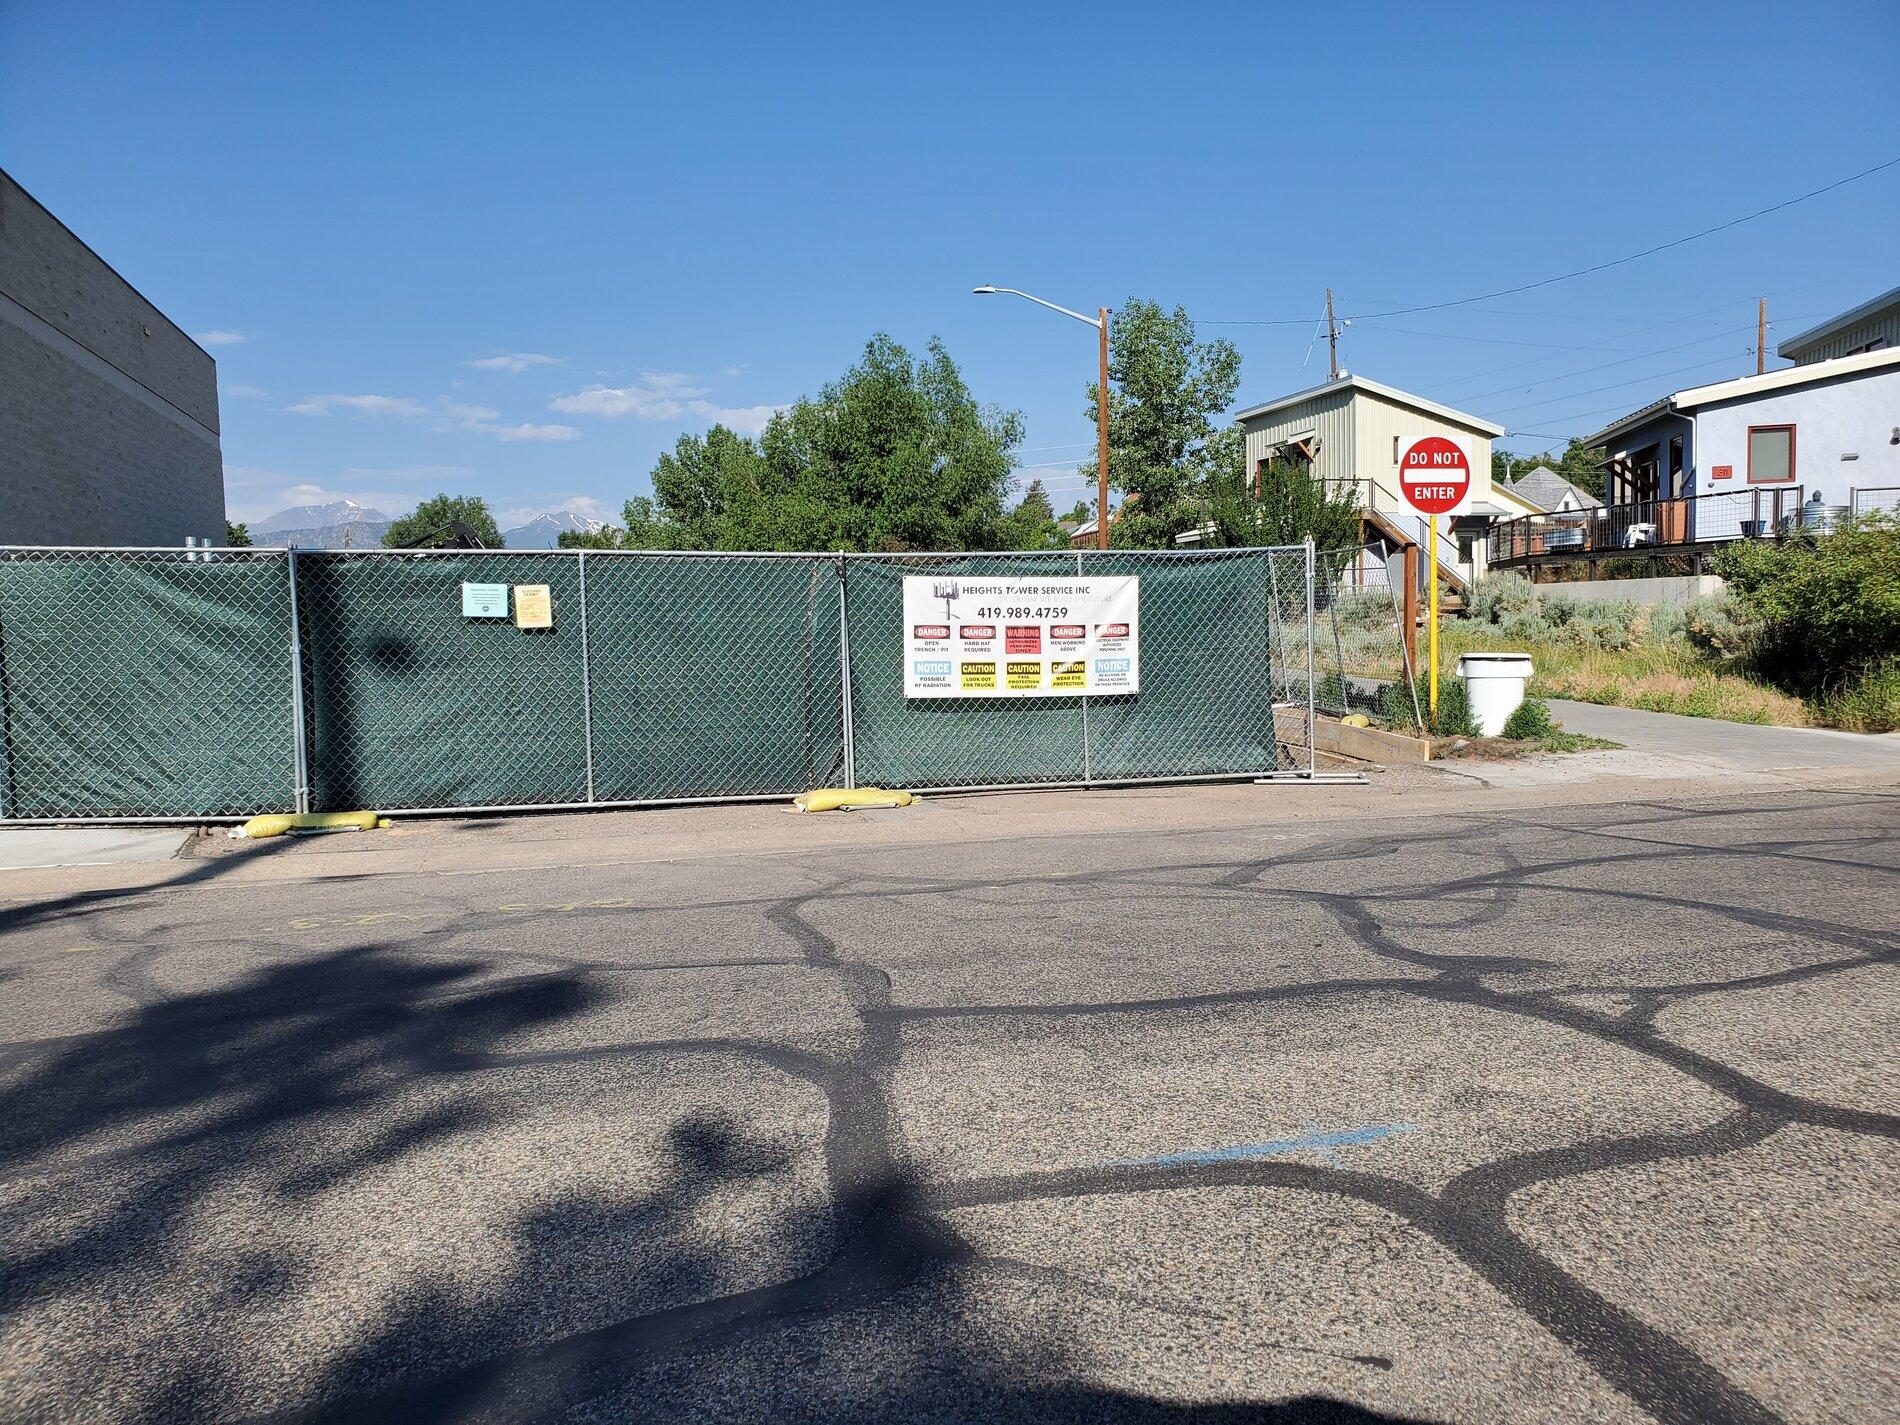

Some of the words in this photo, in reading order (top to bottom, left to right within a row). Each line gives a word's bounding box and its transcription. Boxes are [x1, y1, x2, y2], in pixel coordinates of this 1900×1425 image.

[1409, 452, 1428, 465] DO
[1433, 452, 1460, 465] NOT
[1414, 487, 1456, 499] ENTER
[962, 586, 1003, 594] HEIGHTS
[1006, 586, 1039, 594] TOWER
[1041, 586, 1073, 594] SERVICE
[1075, 586, 1090, 594] INC
[977, 607, 1068, 618] 419.989.4759
[1006, 629, 1040, 637] WARNING
[1054, 628, 1083, 636] DANGER
[917, 663, 949, 673] NOTICE
[962, 665, 995, 673] CAUTION
[1008, 665, 1040, 673] CAUTION
[1052, 664, 1084, 672] CAUTION
[1097, 661, 1128, 671] NOTICE
